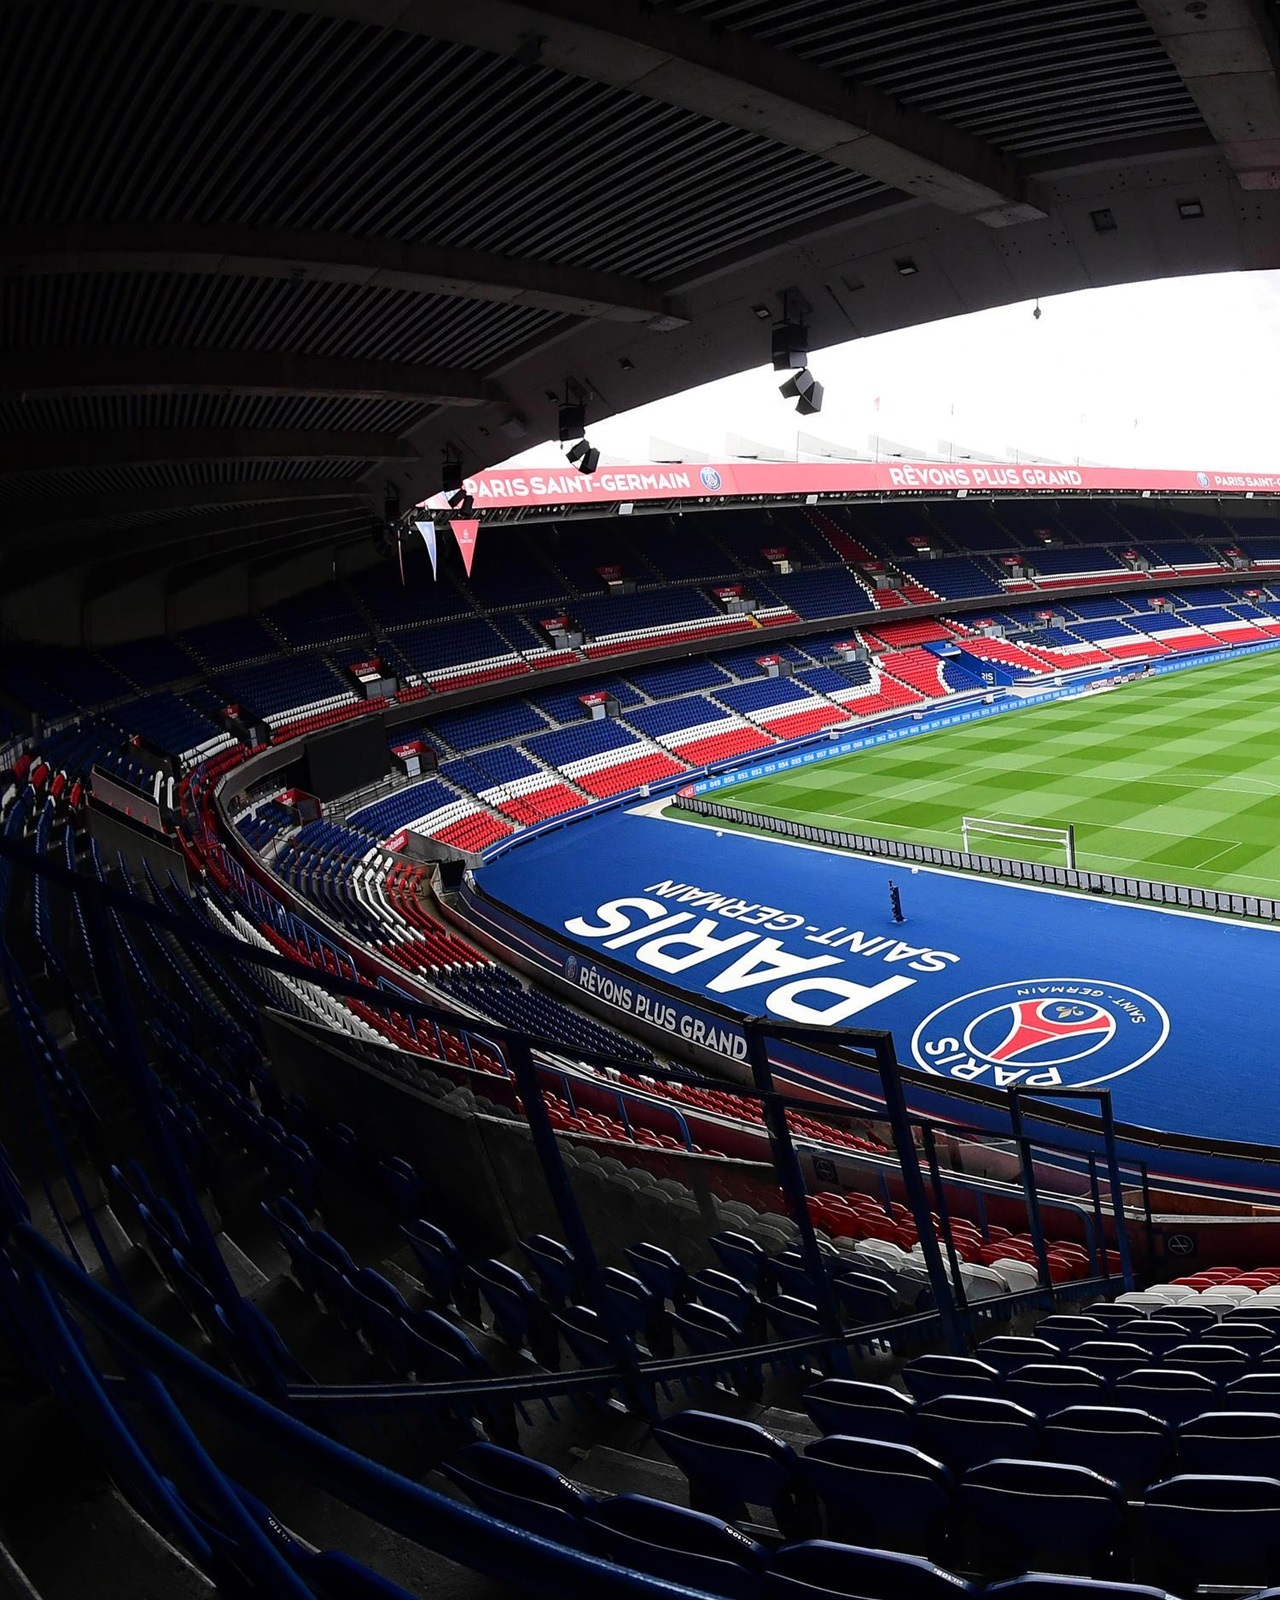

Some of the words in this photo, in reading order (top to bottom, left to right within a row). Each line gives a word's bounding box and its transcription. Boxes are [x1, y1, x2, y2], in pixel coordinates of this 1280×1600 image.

[464, 477, 529, 499] PARIS
[530, 472, 691, 496] SAINT-GERMAIN
[888, 465, 971, 487] RÊVONS
[975, 467, 1021, 486] PLUS
[1024, 468, 1083, 486] GRAND
[1214, 475, 1245, 488] PARIS
[981, 672, 994, 681] RIS
[710, 779, 721, 788] 049
[724, 775, 735, 784] 050
[737, 772, 749, 780] 051
[644, 879, 961, 972] SAINT-GERMAIN
[564, 897, 917, 1026] PARIS
[580, 966, 632, 1011] RÊVONS
[635, 993, 676, 1031] PLUS
[680, 1015, 748, 1061] GRAND
[925, 1037, 1063, 1091] PARIS
